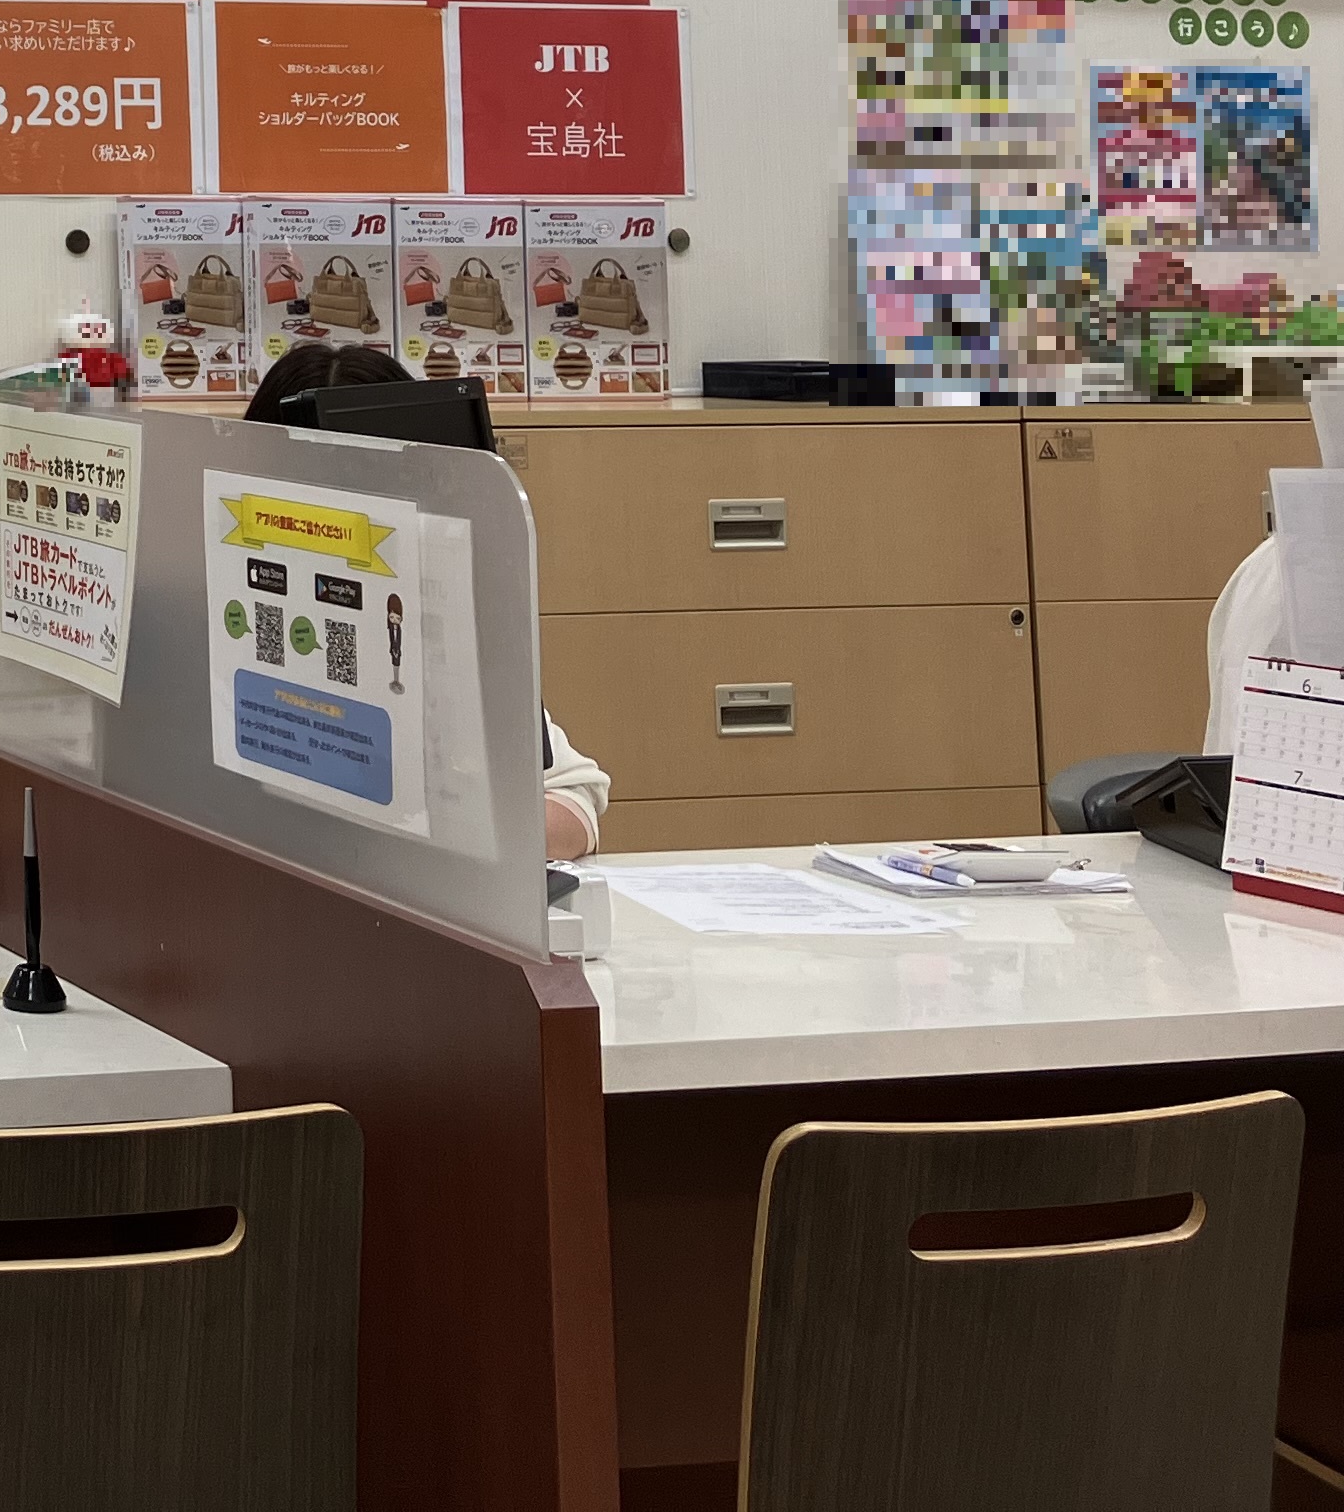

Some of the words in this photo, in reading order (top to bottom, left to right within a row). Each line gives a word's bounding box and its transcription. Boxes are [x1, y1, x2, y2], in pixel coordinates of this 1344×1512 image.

[534, 44, 610, 72] JTB
[290, 92, 366, 107] キルティング
[258, 111, 400, 126] ショルダーバッグBOOK
[527, 121, 626, 158] 宝島社
[351, 214, 386, 237] JTB
[485, 216, 518, 239] JTB
[620, 217, 655, 240] JTB
[1302, 679, 1311, 693] 6
[1294, 770, 1303, 785] 7
